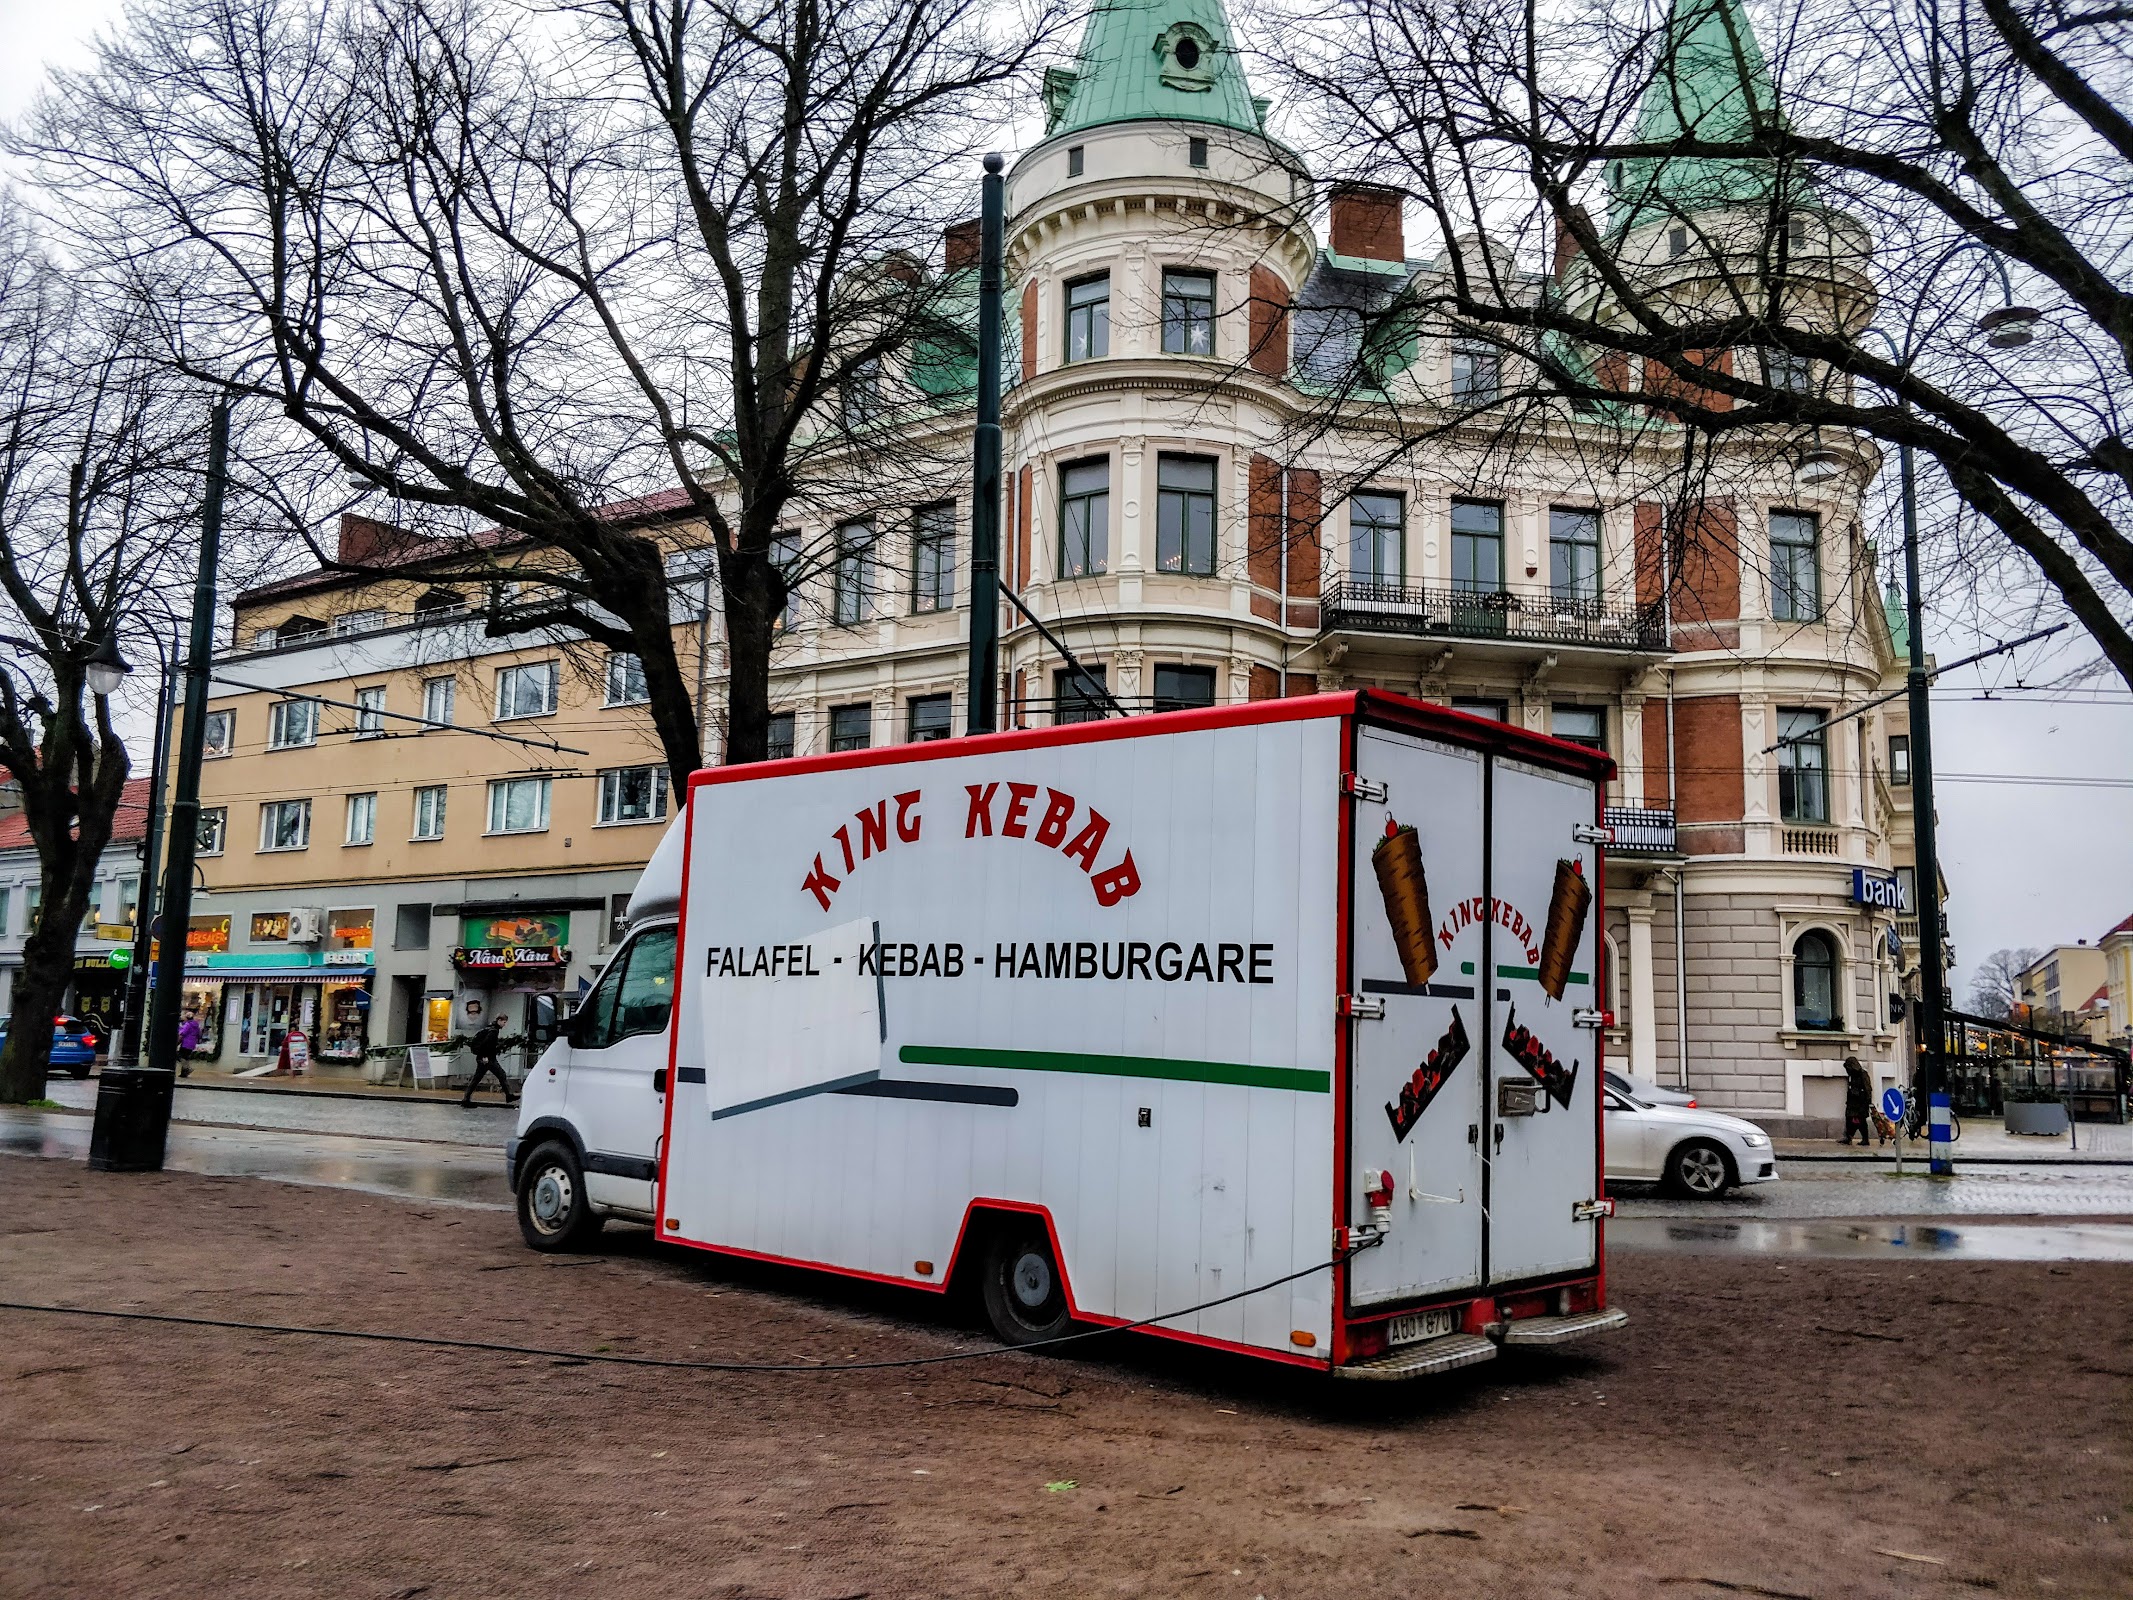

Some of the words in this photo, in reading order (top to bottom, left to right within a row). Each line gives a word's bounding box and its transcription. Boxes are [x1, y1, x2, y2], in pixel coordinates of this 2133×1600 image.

[801, 789, 921, 912] KING
[965, 782, 1141, 907] KEBAB
[1862, 869, 1907, 909] bank
[1438, 897, 1484, 952] KING
[1491, 897, 1540, 965] KEBAB
[468, 949, 504, 965] Nära
[514, 948, 550, 963] Kära
[706, 944, 820, 978] FALAFEL
[857, 942, 965, 979] KEBAB
[995, 941, 1274, 984] HAMBURGARE
